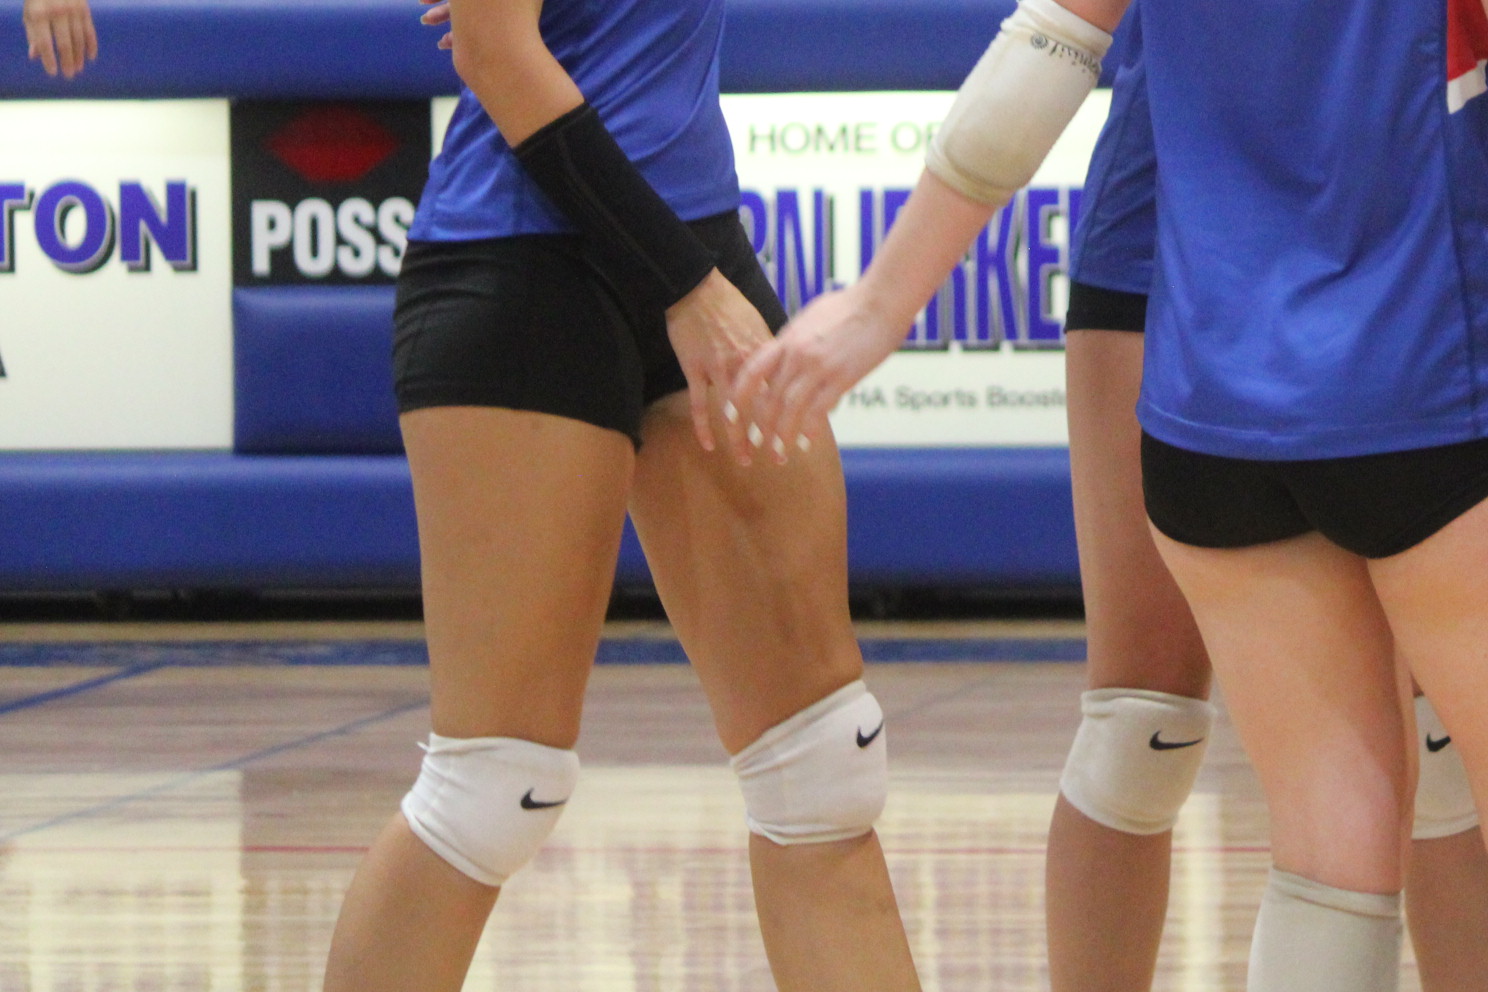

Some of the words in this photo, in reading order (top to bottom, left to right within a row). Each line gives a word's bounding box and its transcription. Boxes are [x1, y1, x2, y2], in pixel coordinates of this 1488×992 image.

[748, 121, 878, 155] HOME
[250, 197, 417, 278] POSS
[895, 384, 977, 411] Sports
